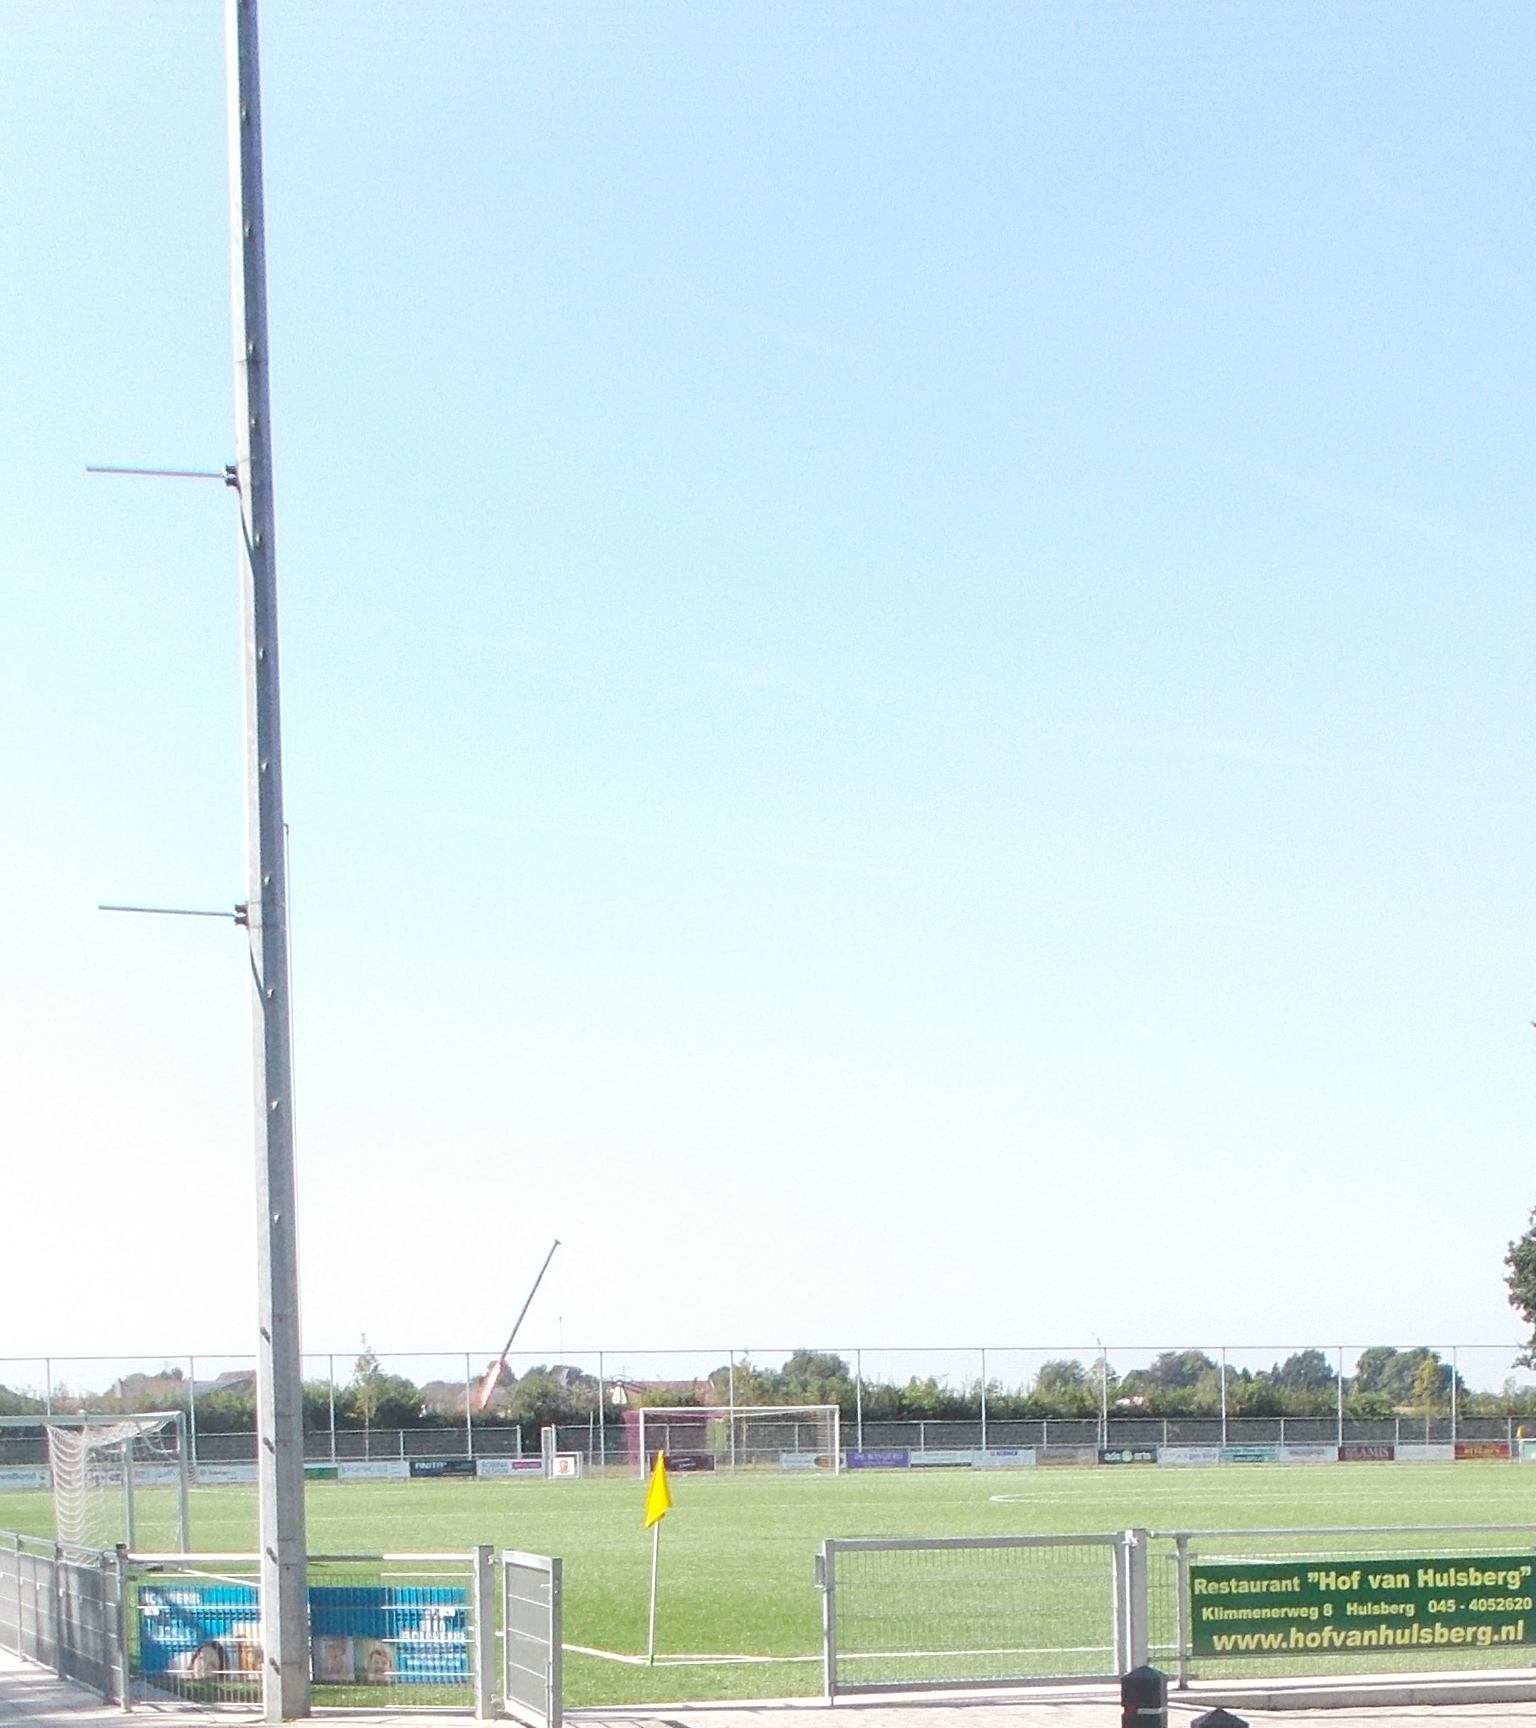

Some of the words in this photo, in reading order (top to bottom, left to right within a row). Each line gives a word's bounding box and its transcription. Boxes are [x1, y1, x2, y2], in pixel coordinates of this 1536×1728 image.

[1193, 1575, 1301, 1596] Restaurant
[1367, 1574, 1411, 1590] van
[1202, 1603, 1319, 1622] Klimmenerweg
[1323, 1604, 1333, 1617] 8
[1346, 1600, 1416, 1617] Hulsberg
[1427, 1598, 1457, 1613] 045
[1468, 1597, 1533, 1612] 4052620
[1212, 1619, 1525, 1652] www.hofvanhulsberg.nl
